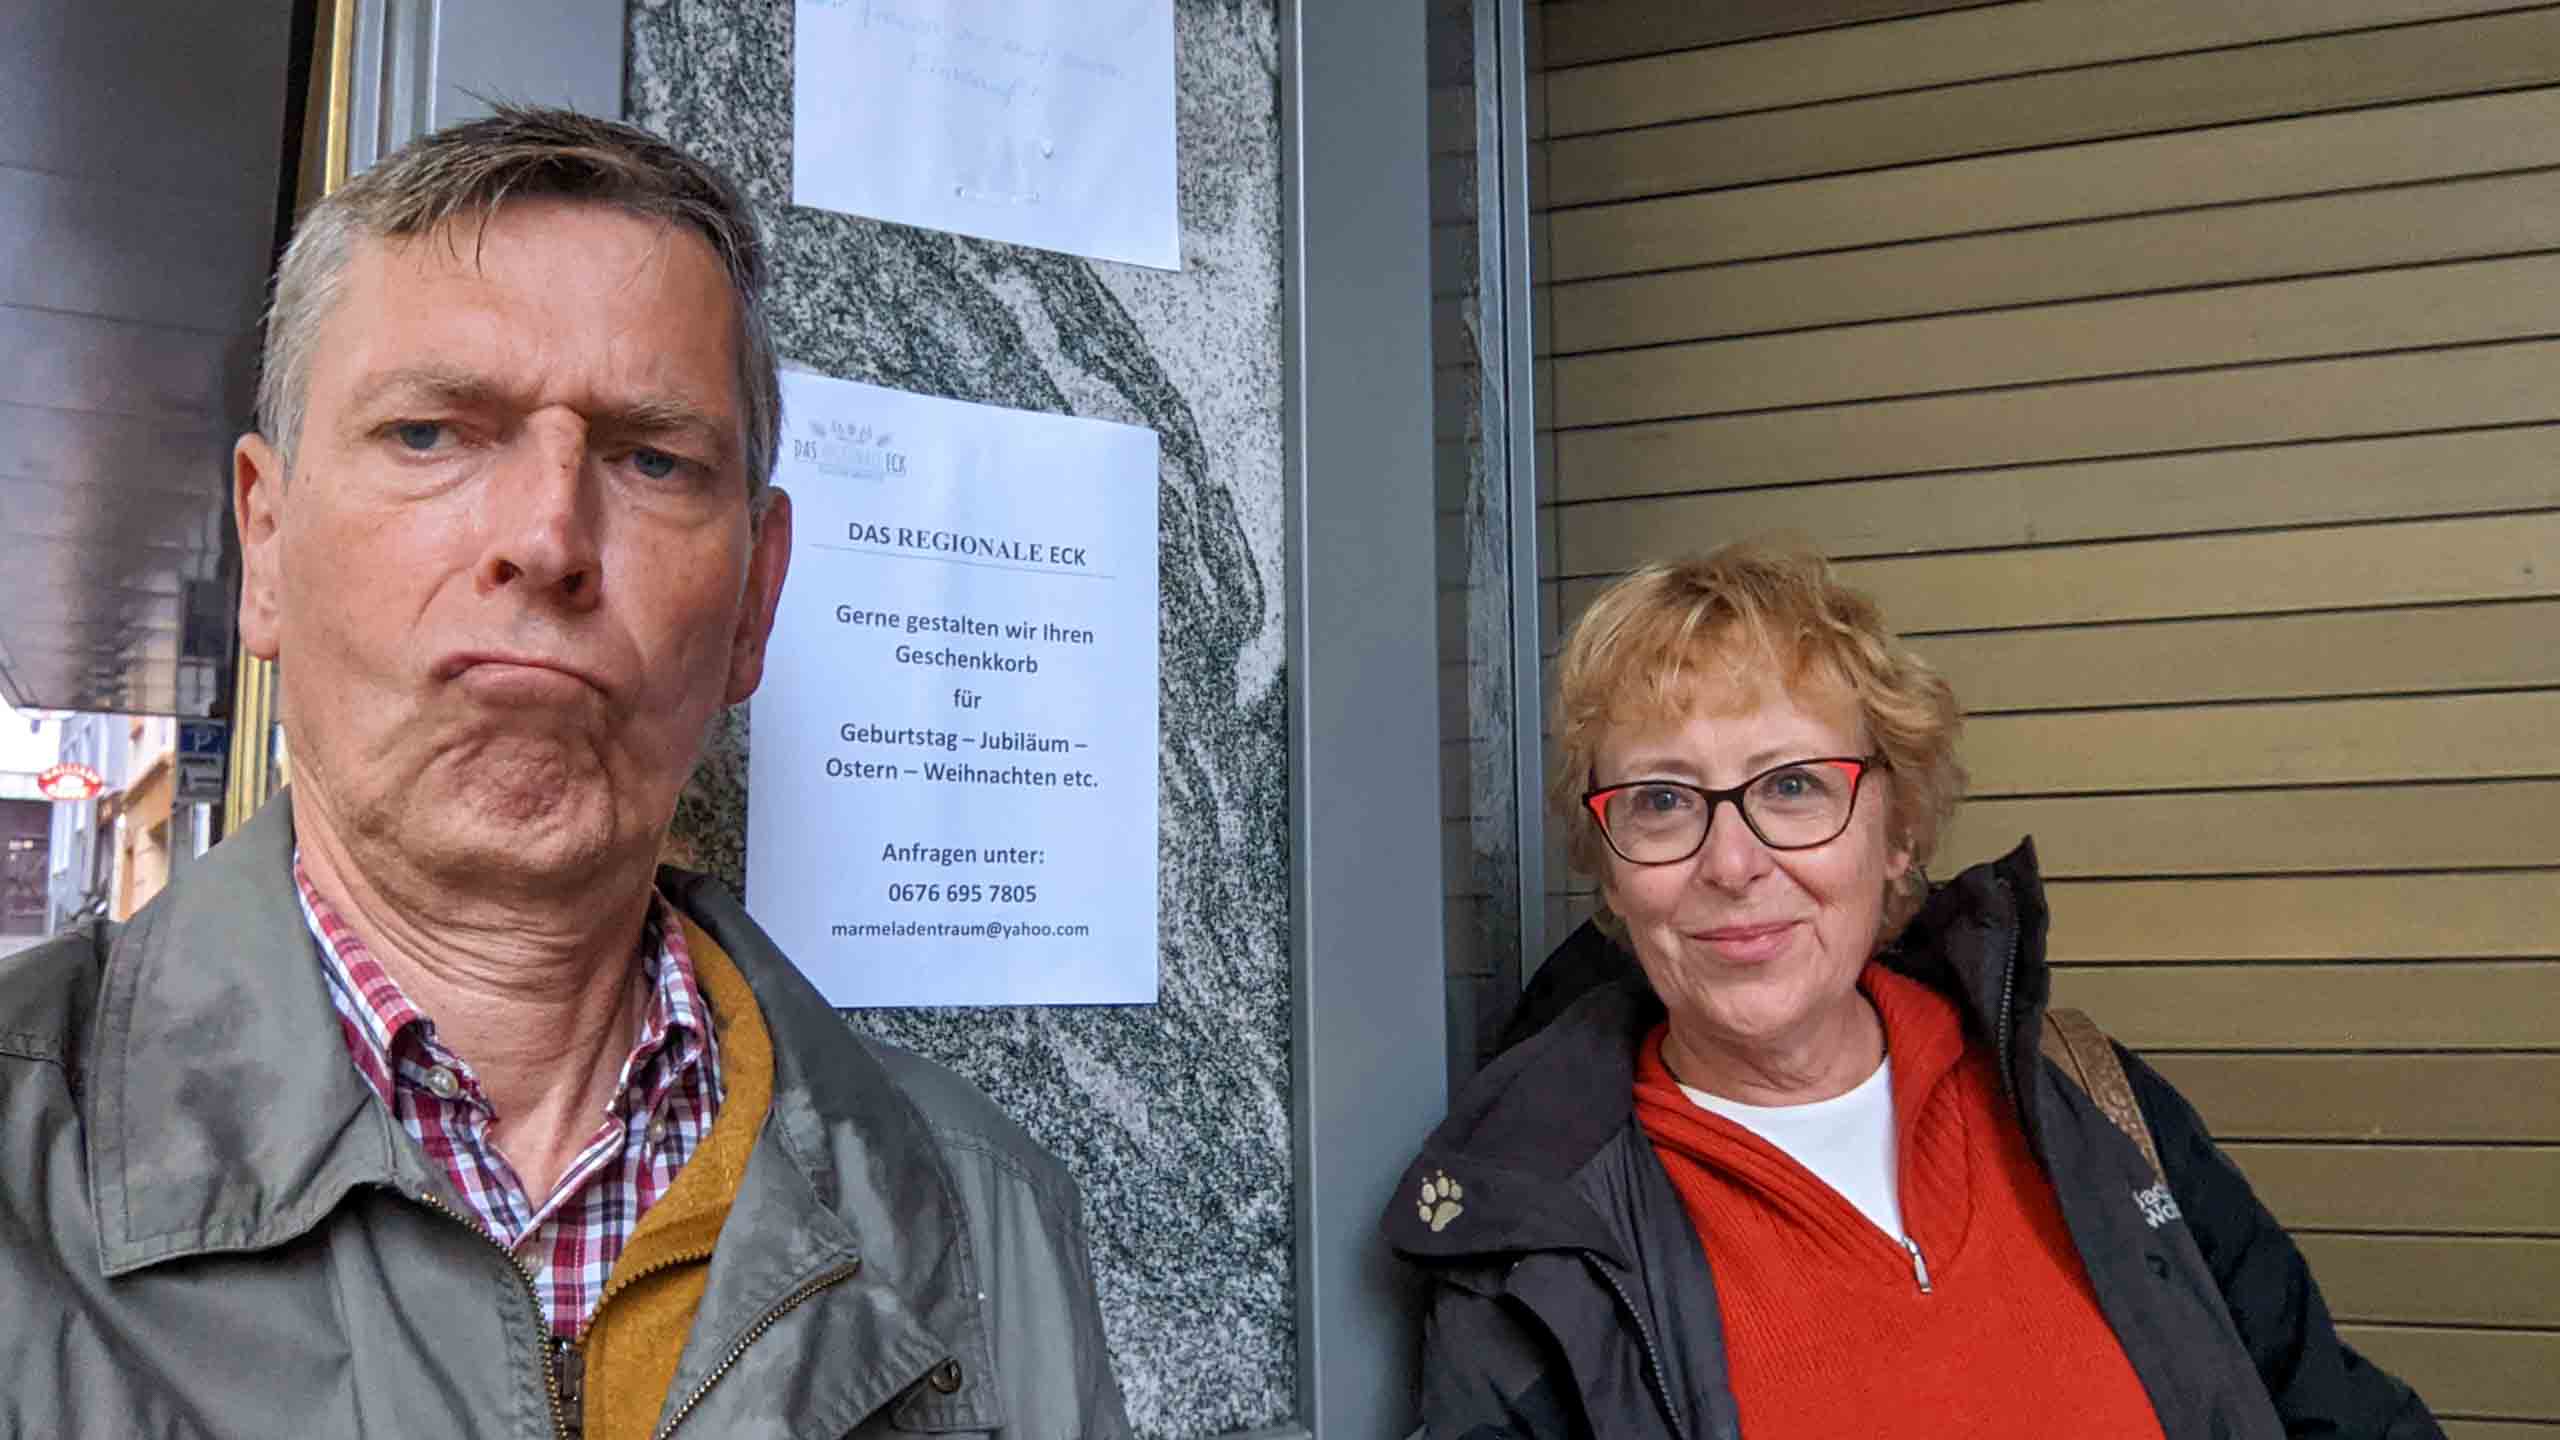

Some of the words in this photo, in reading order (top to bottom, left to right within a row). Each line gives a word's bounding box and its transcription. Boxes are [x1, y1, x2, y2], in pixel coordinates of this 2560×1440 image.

[849, 523, 891, 544] DAS
[898, 528, 1042, 562] REGIONALE
[1050, 546, 1086, 566] ECK
[836, 605, 900, 628] Gerne
[906, 616, 999, 638] gestalten
[1005, 621, 1037, 640] wir
[1044, 624, 1093, 644] Ihren
[896, 645, 1038, 674] Geschenkkorb
[953, 688, 982, 709] für
[841, 723, 958, 751] Geburtstag
[980, 731, 1069, 752] Jubiläum
[826, 758, 897, 779] Ostern
[924, 762, 1056, 786] Weihnachten
[1063, 770, 1098, 787] etc.
[882, 842, 976, 867] Anfragen
[984, 848, 1044, 864] unter:
[889, 883, 940, 902] 0676
[947, 884, 982, 902] 695
[989, 885, 1036, 903] 7805
[832, 920, 1088, 939] marmeladentraum@yahoo.com
